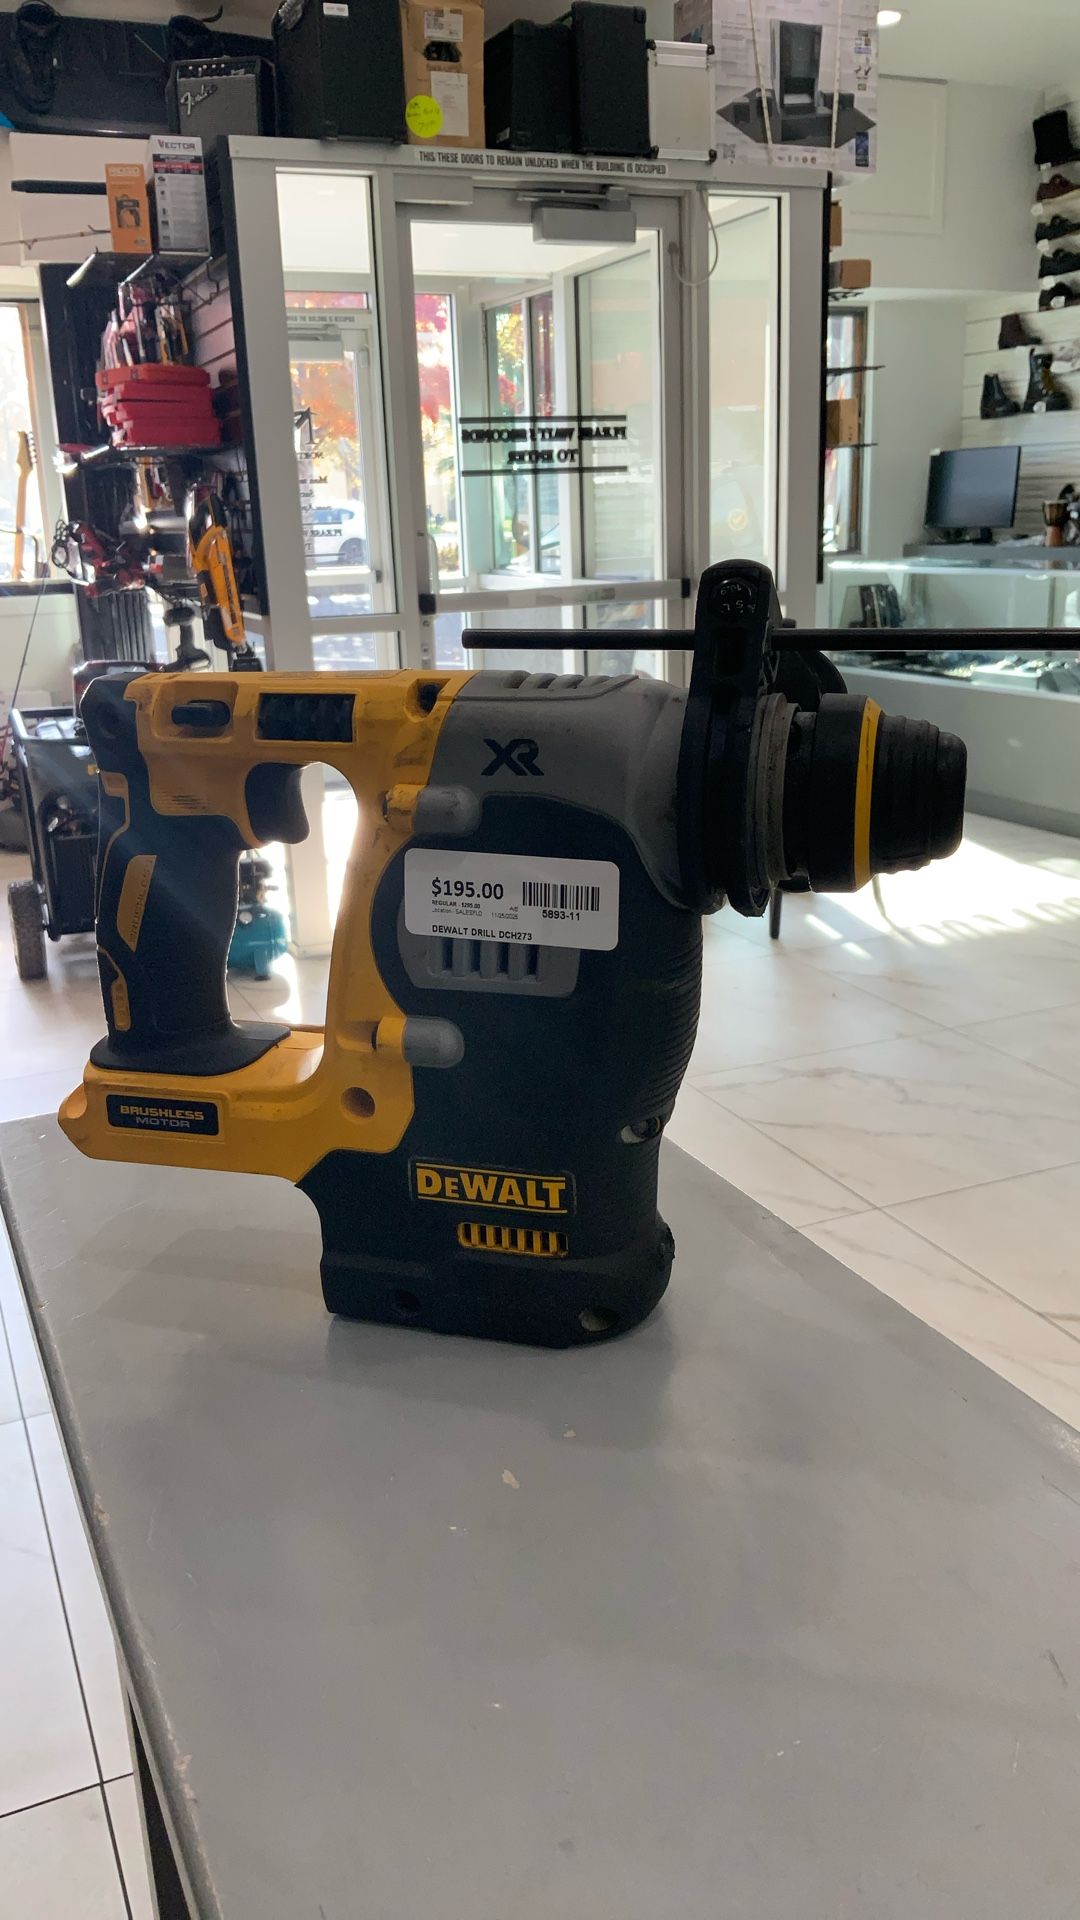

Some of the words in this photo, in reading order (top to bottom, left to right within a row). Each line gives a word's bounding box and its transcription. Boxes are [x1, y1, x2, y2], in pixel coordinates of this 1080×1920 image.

[158, 138, 196, 150] VECTOR
[461, 153, 483, 165] DOORS
[486, 154, 495, 165] TO
[497, 155, 522, 166] REMAIN
[525, 156, 558, 168] UNLOCKED
[561, 159, 580, 169] WHEN
[582, 160, 593, 170] THE
[596, 161, 625, 172] BUILDING
[635, 163, 666, 174] OCCUPIED
[480, 738, 545, 777] XR
[431, 876, 504, 900] $195.00
[431, 899, 457, 907] REGULAR
[461, 901, 481, 909] $295.00
[542, 909, 581, 921] 5893-11
[432, 924, 468, 936] DEWALT
[471, 928, 496, 938] DRILL
[498, 930, 533, 941] DCH273
[120, 1105, 204, 1121] BRUSHLESS
[136, 1116, 191, 1128] MOTOR
[416, 1167, 566, 1209] DEWALT
